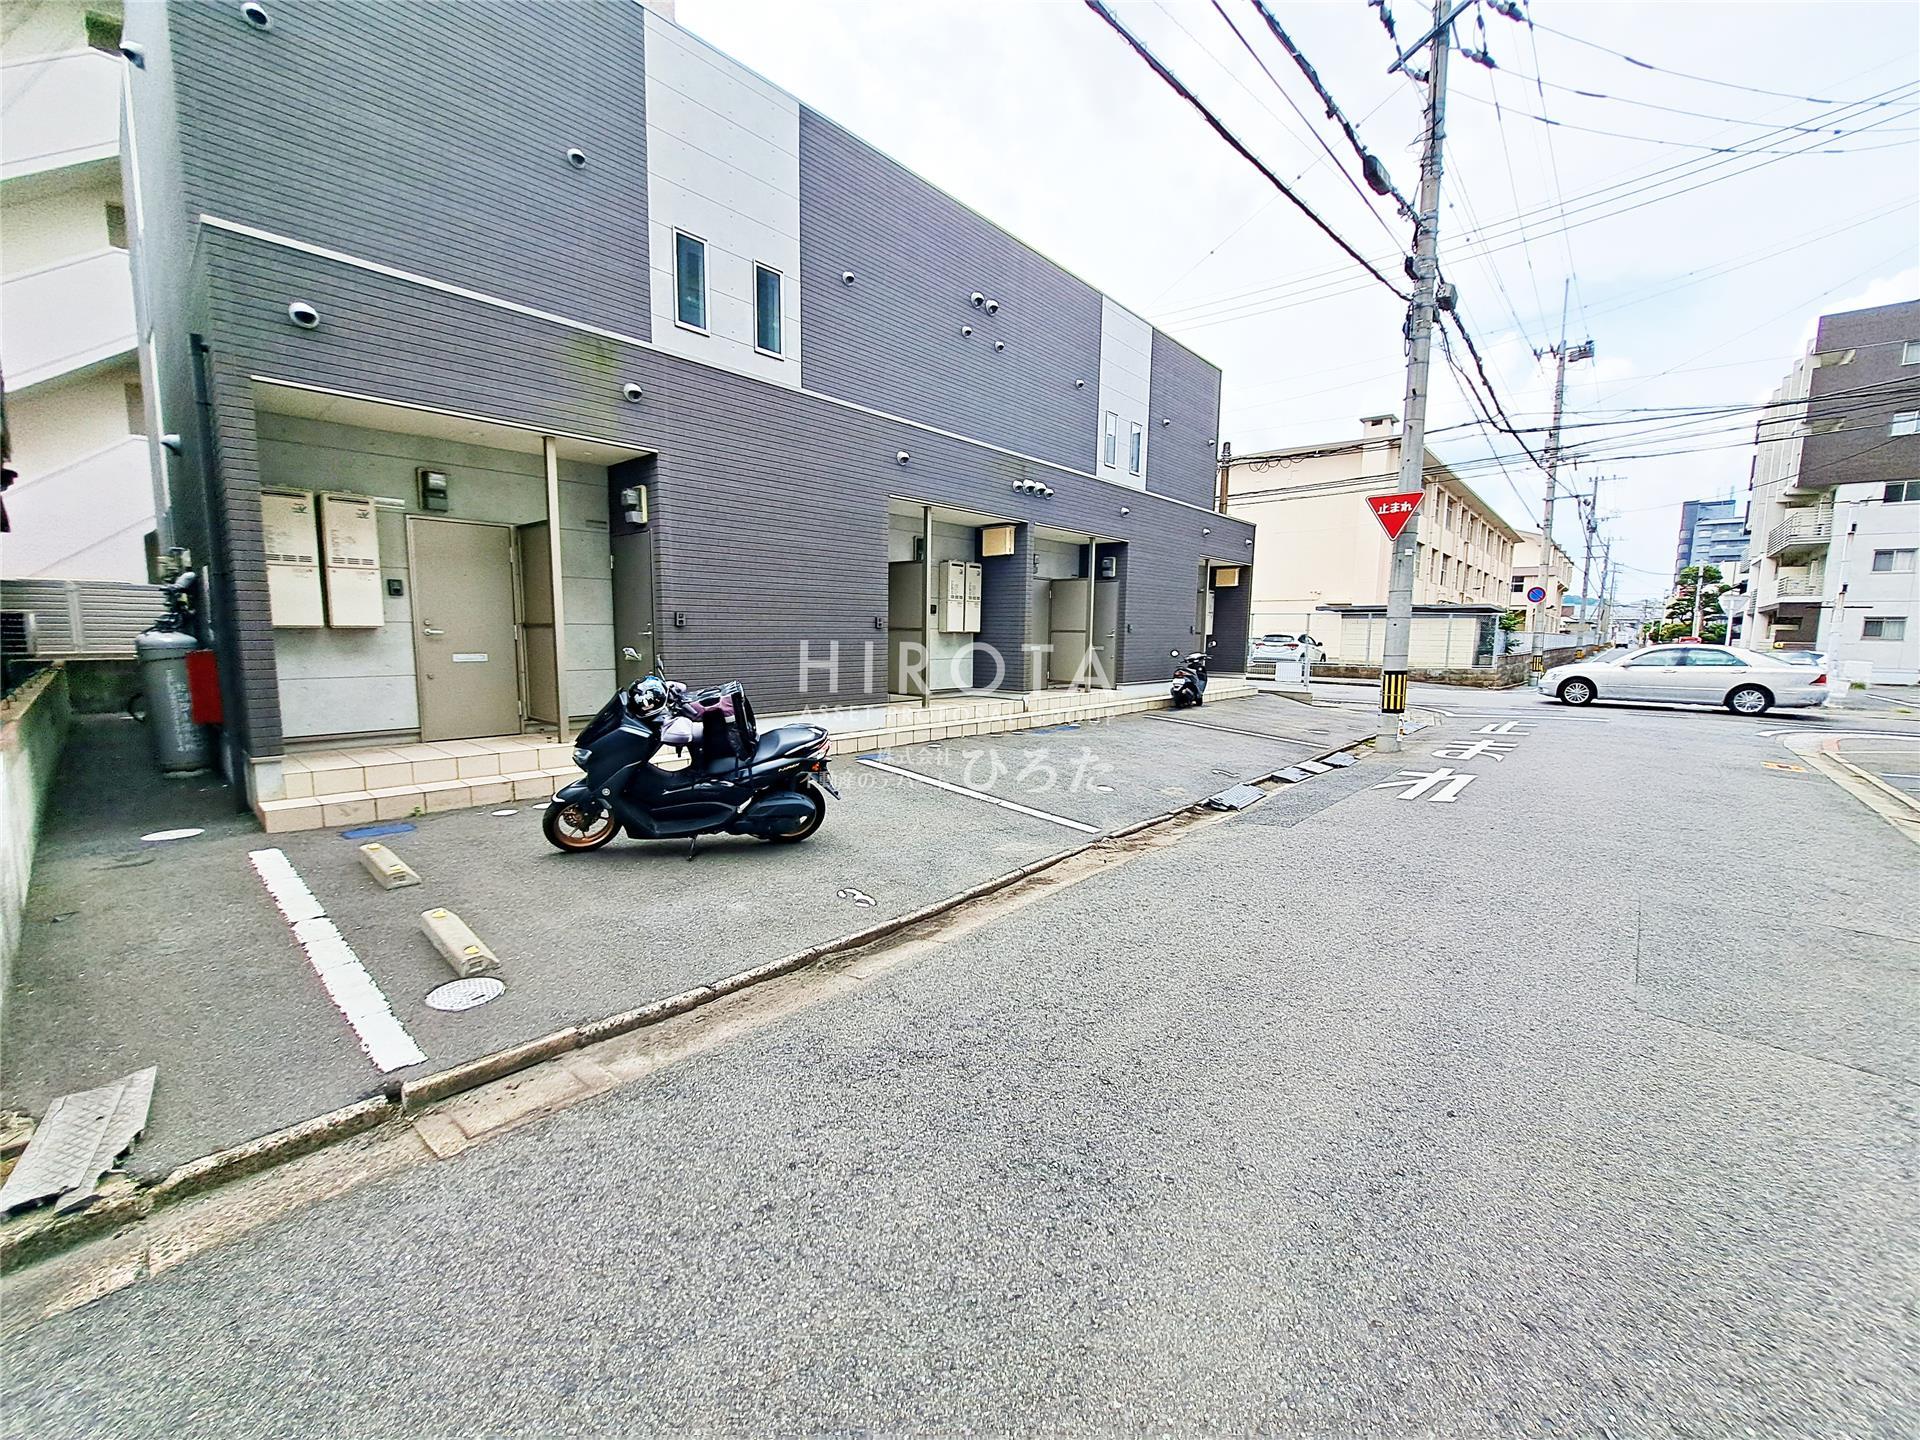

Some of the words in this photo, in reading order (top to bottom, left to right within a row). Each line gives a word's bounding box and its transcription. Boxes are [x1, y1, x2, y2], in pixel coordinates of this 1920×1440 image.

[1377, 501, 1413, 515] 止まれ
[1371, 720, 1538, 803] 止まれ
